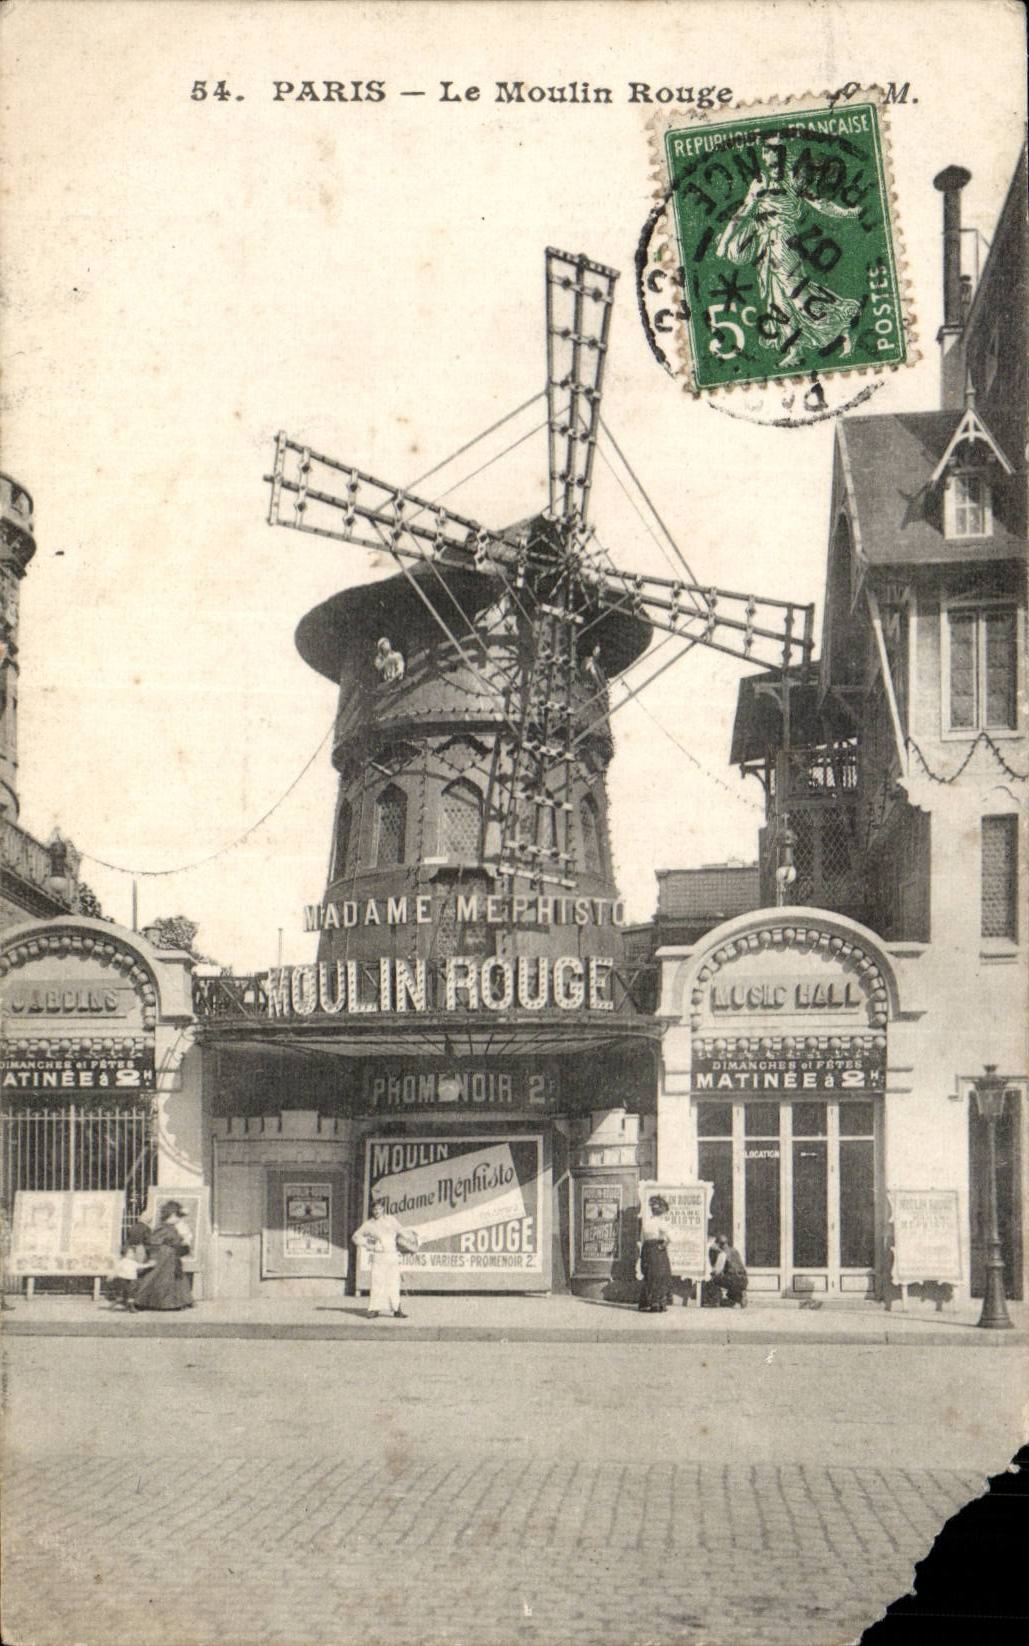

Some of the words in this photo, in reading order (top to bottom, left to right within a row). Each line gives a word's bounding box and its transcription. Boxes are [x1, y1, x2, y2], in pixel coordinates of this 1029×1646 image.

[869, 262, 896, 352] POSTES
[303, 895, 433, 933] MADAME
[456, 895, 626, 927] MEPHISTO
[264, 955, 427, 1017] MOULIN
[446, 956, 615, 1011] ROUGE
[711, 983, 788, 1011] MUSIC
[795, 982, 862, 1010] HALL
[2, 1069, 94, 1087] ATINÉE
[696, 1070, 818, 1089] MATINÉE
[712, 1060, 797, 1071] DIMANCHES
[372, 1142, 450, 1178] MOULIN
[744, 1149, 780, 1159] LOCATION
[437, 1161, 515, 1209] Méphisto
[460, 1215, 534, 1254] ROUGE
[470, 1254, 523, 1268] PROMENOIR
